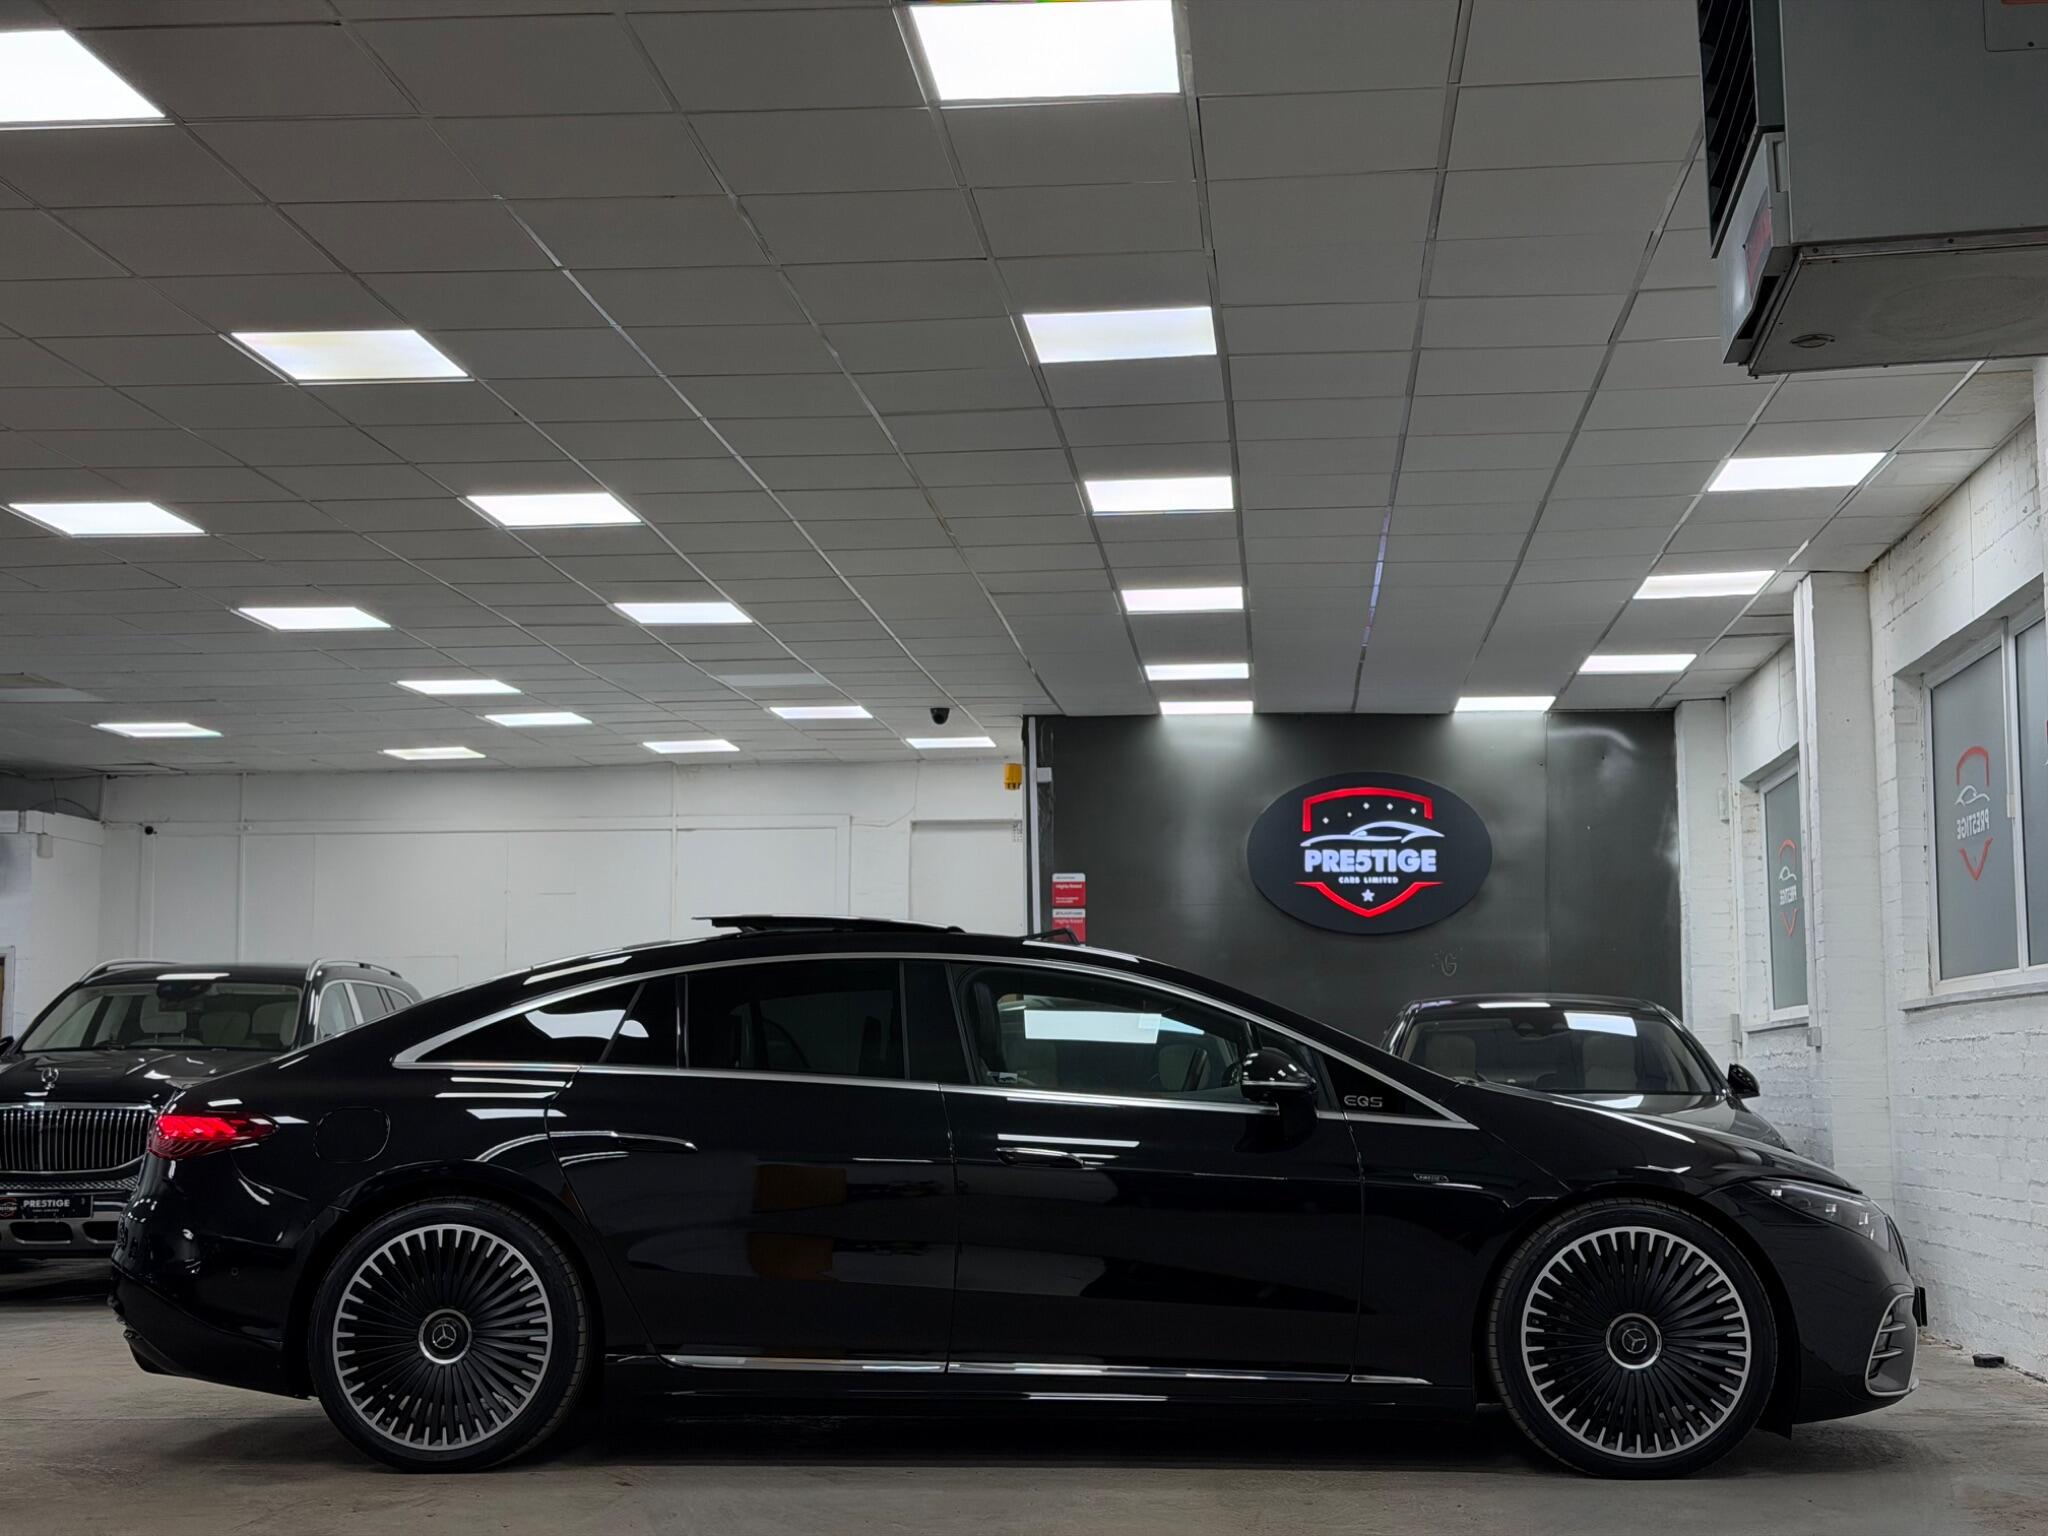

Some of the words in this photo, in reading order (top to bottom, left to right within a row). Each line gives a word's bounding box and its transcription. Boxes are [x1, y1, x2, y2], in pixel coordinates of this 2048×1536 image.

[1363, 876, 1399, 884] LIMITED
[1343, 1095, 1383, 1108] EQS
[23, 1199, 71, 1208] PRESTIGE
